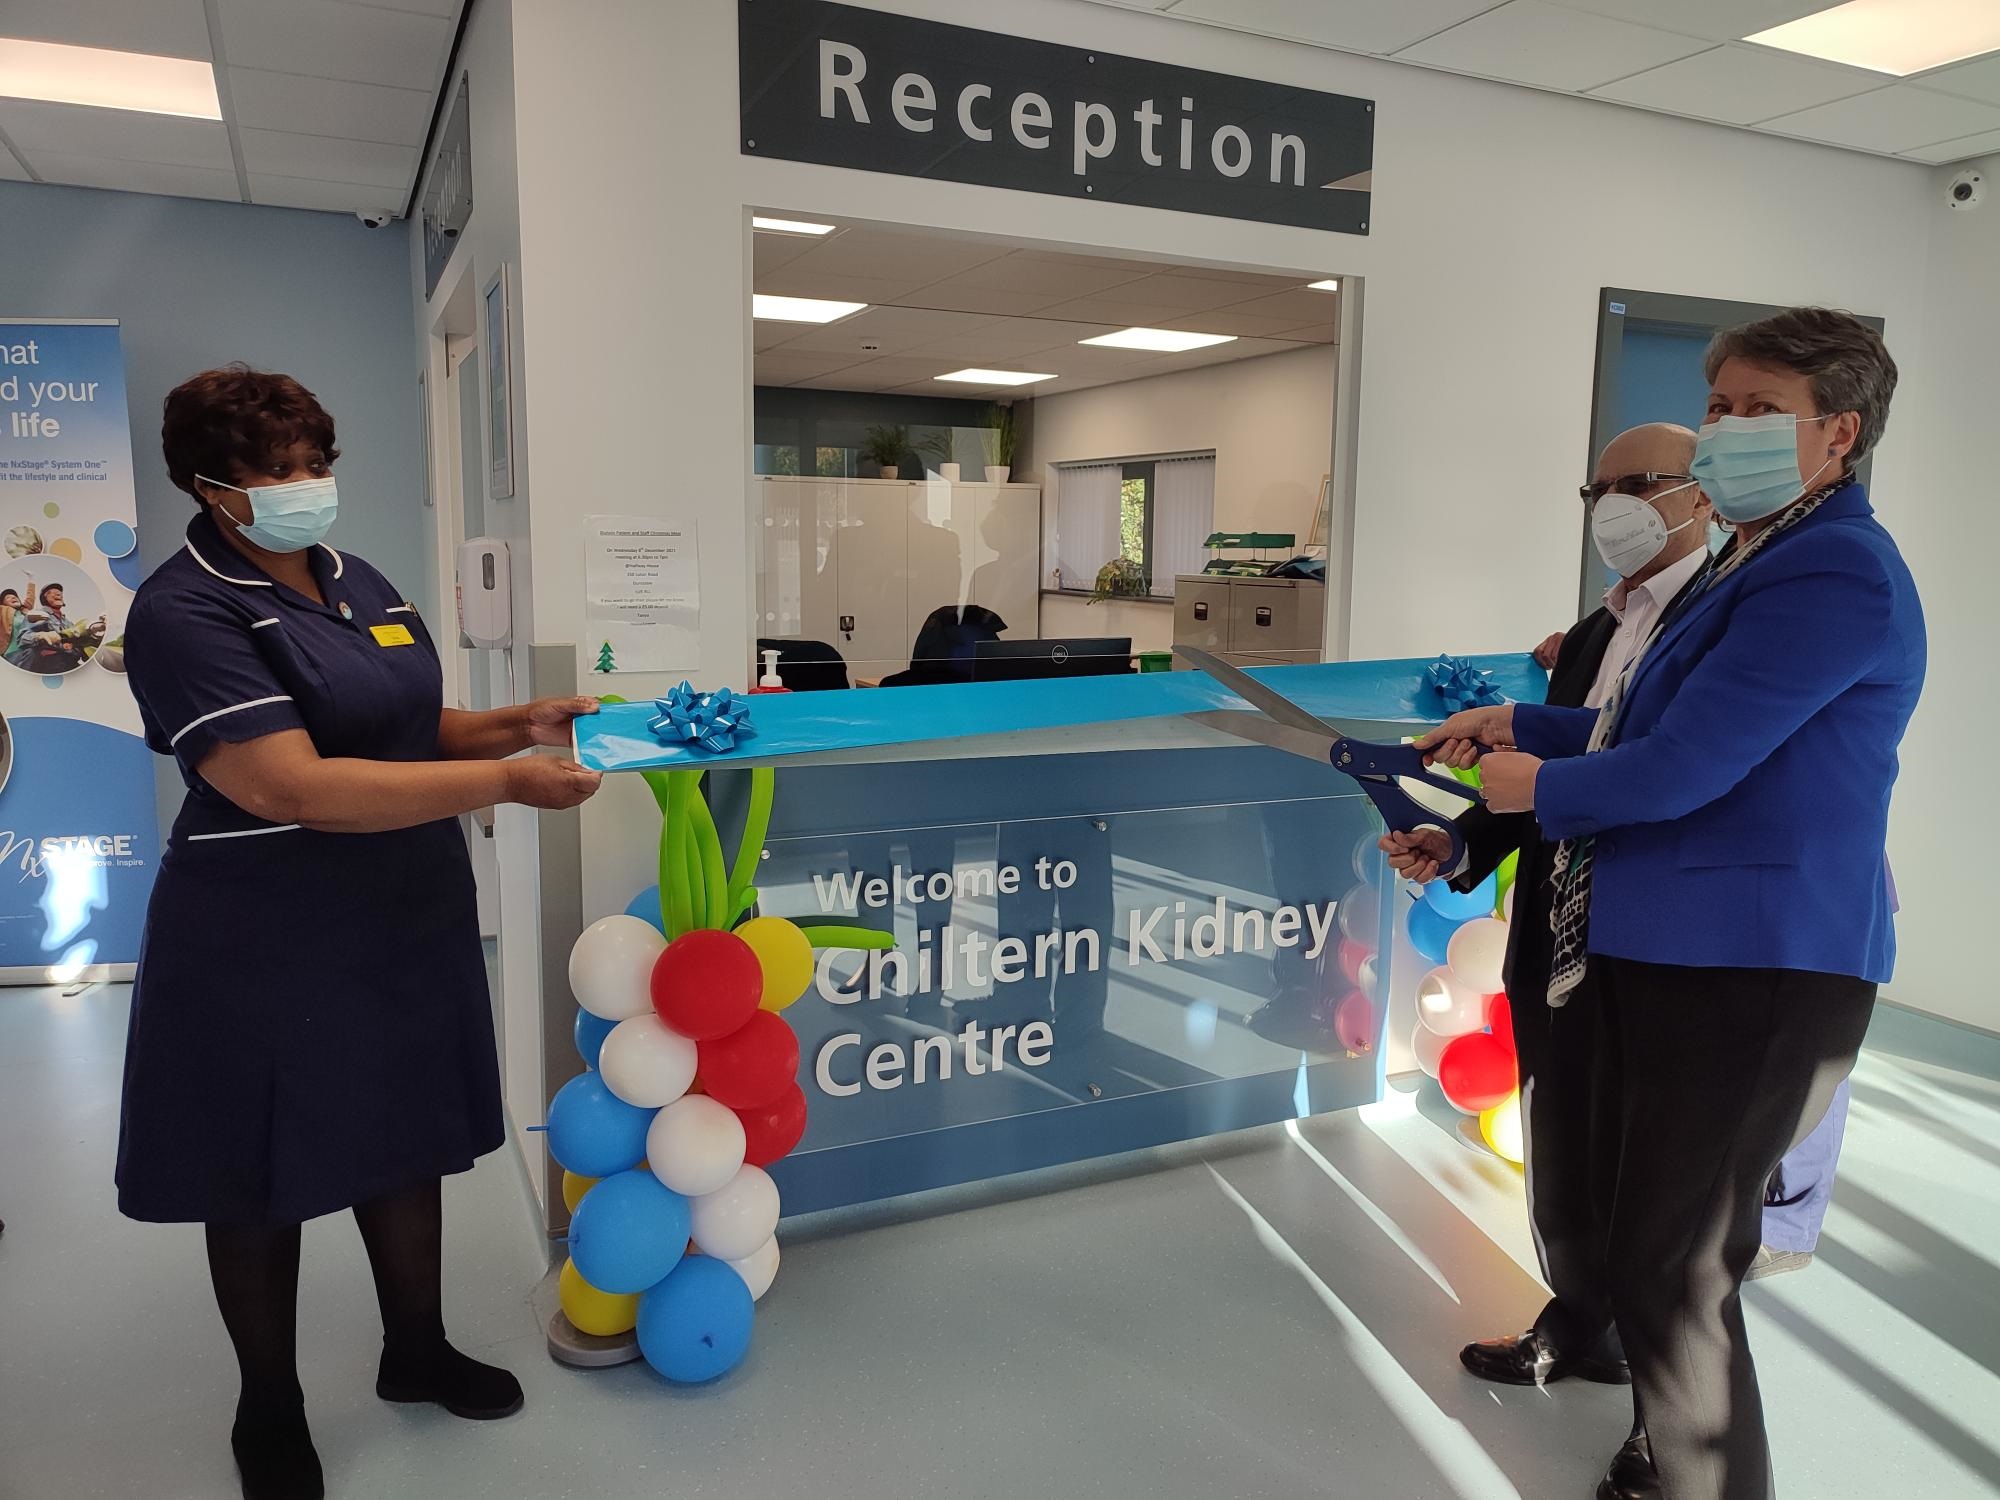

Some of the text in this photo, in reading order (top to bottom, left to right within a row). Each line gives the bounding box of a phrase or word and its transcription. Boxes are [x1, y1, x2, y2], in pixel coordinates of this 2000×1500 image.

[818, 38, 1307, 187] Reception
[28, 381, 99, 408] your
[11, 412, 60, 438] life
[25, 472, 57, 482] lifestyle
[59, 473, 74, 481] and
[76, 473, 107, 481] clinical
[51, 460, 82, 470] System
[116, 859, 146, 868] Inspire.
[813, 855, 1077, 912] Welcome to
[1128, 895, 1338, 967] Kidney
[814, 1018, 1055, 1097] Centre
